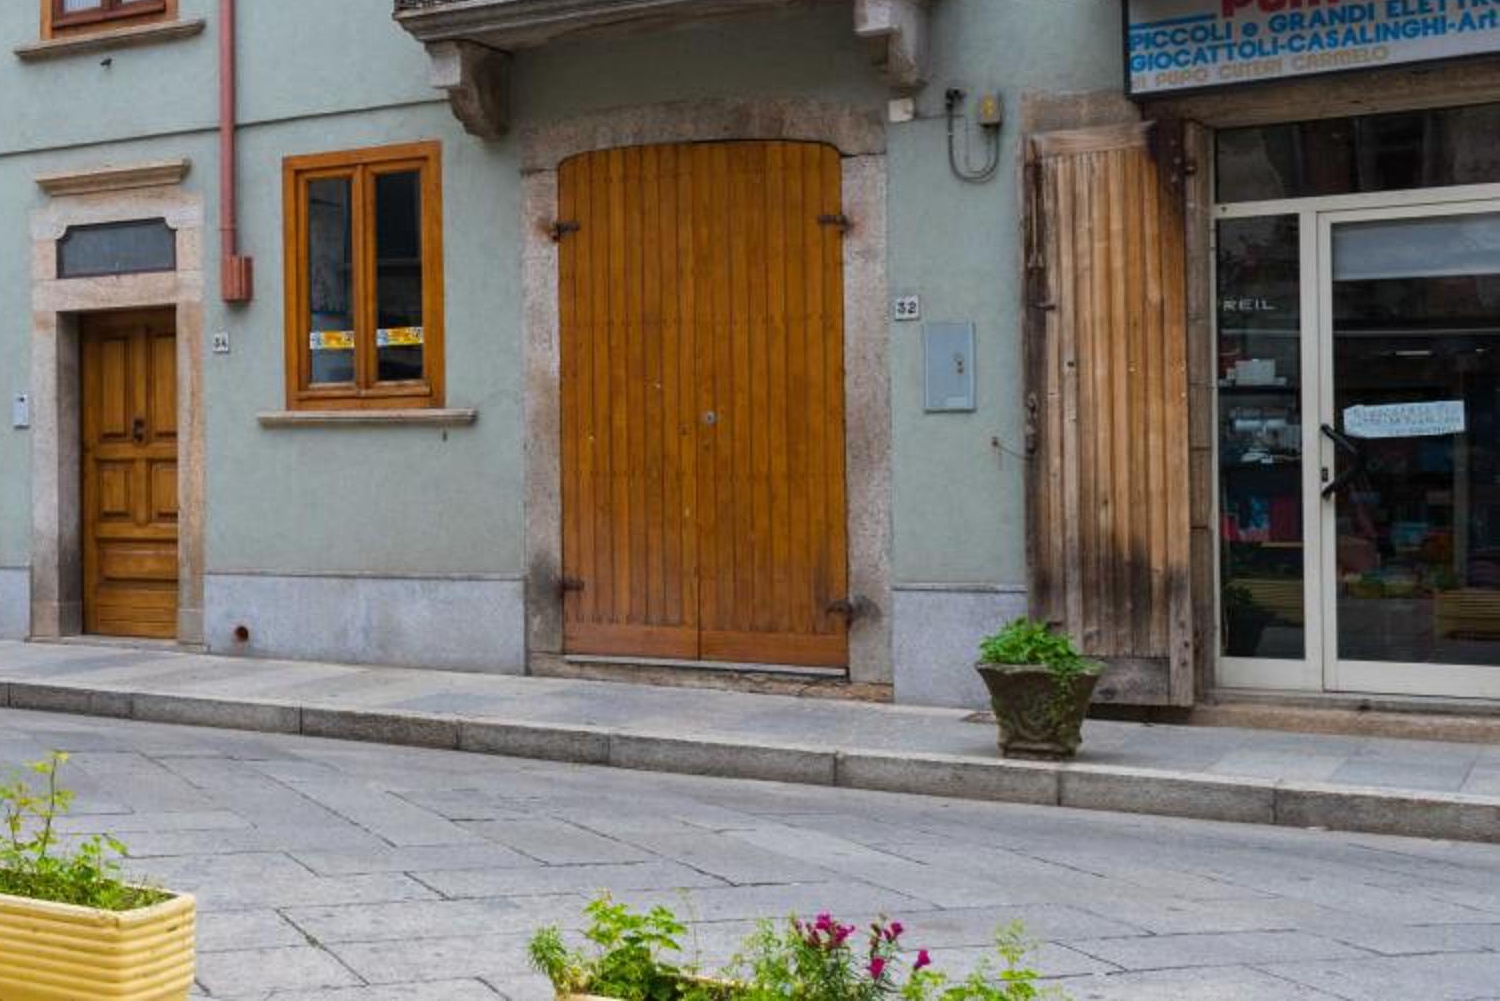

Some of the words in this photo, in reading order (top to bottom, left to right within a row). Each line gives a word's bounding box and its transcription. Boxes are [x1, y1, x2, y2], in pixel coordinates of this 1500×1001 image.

[1130, 22, 1232, 49] PICCOLI
[1242, 22, 1258, 37] e
[1268, 3, 1374, 33] GRANDI
[897, 301, 916, 314] 32
